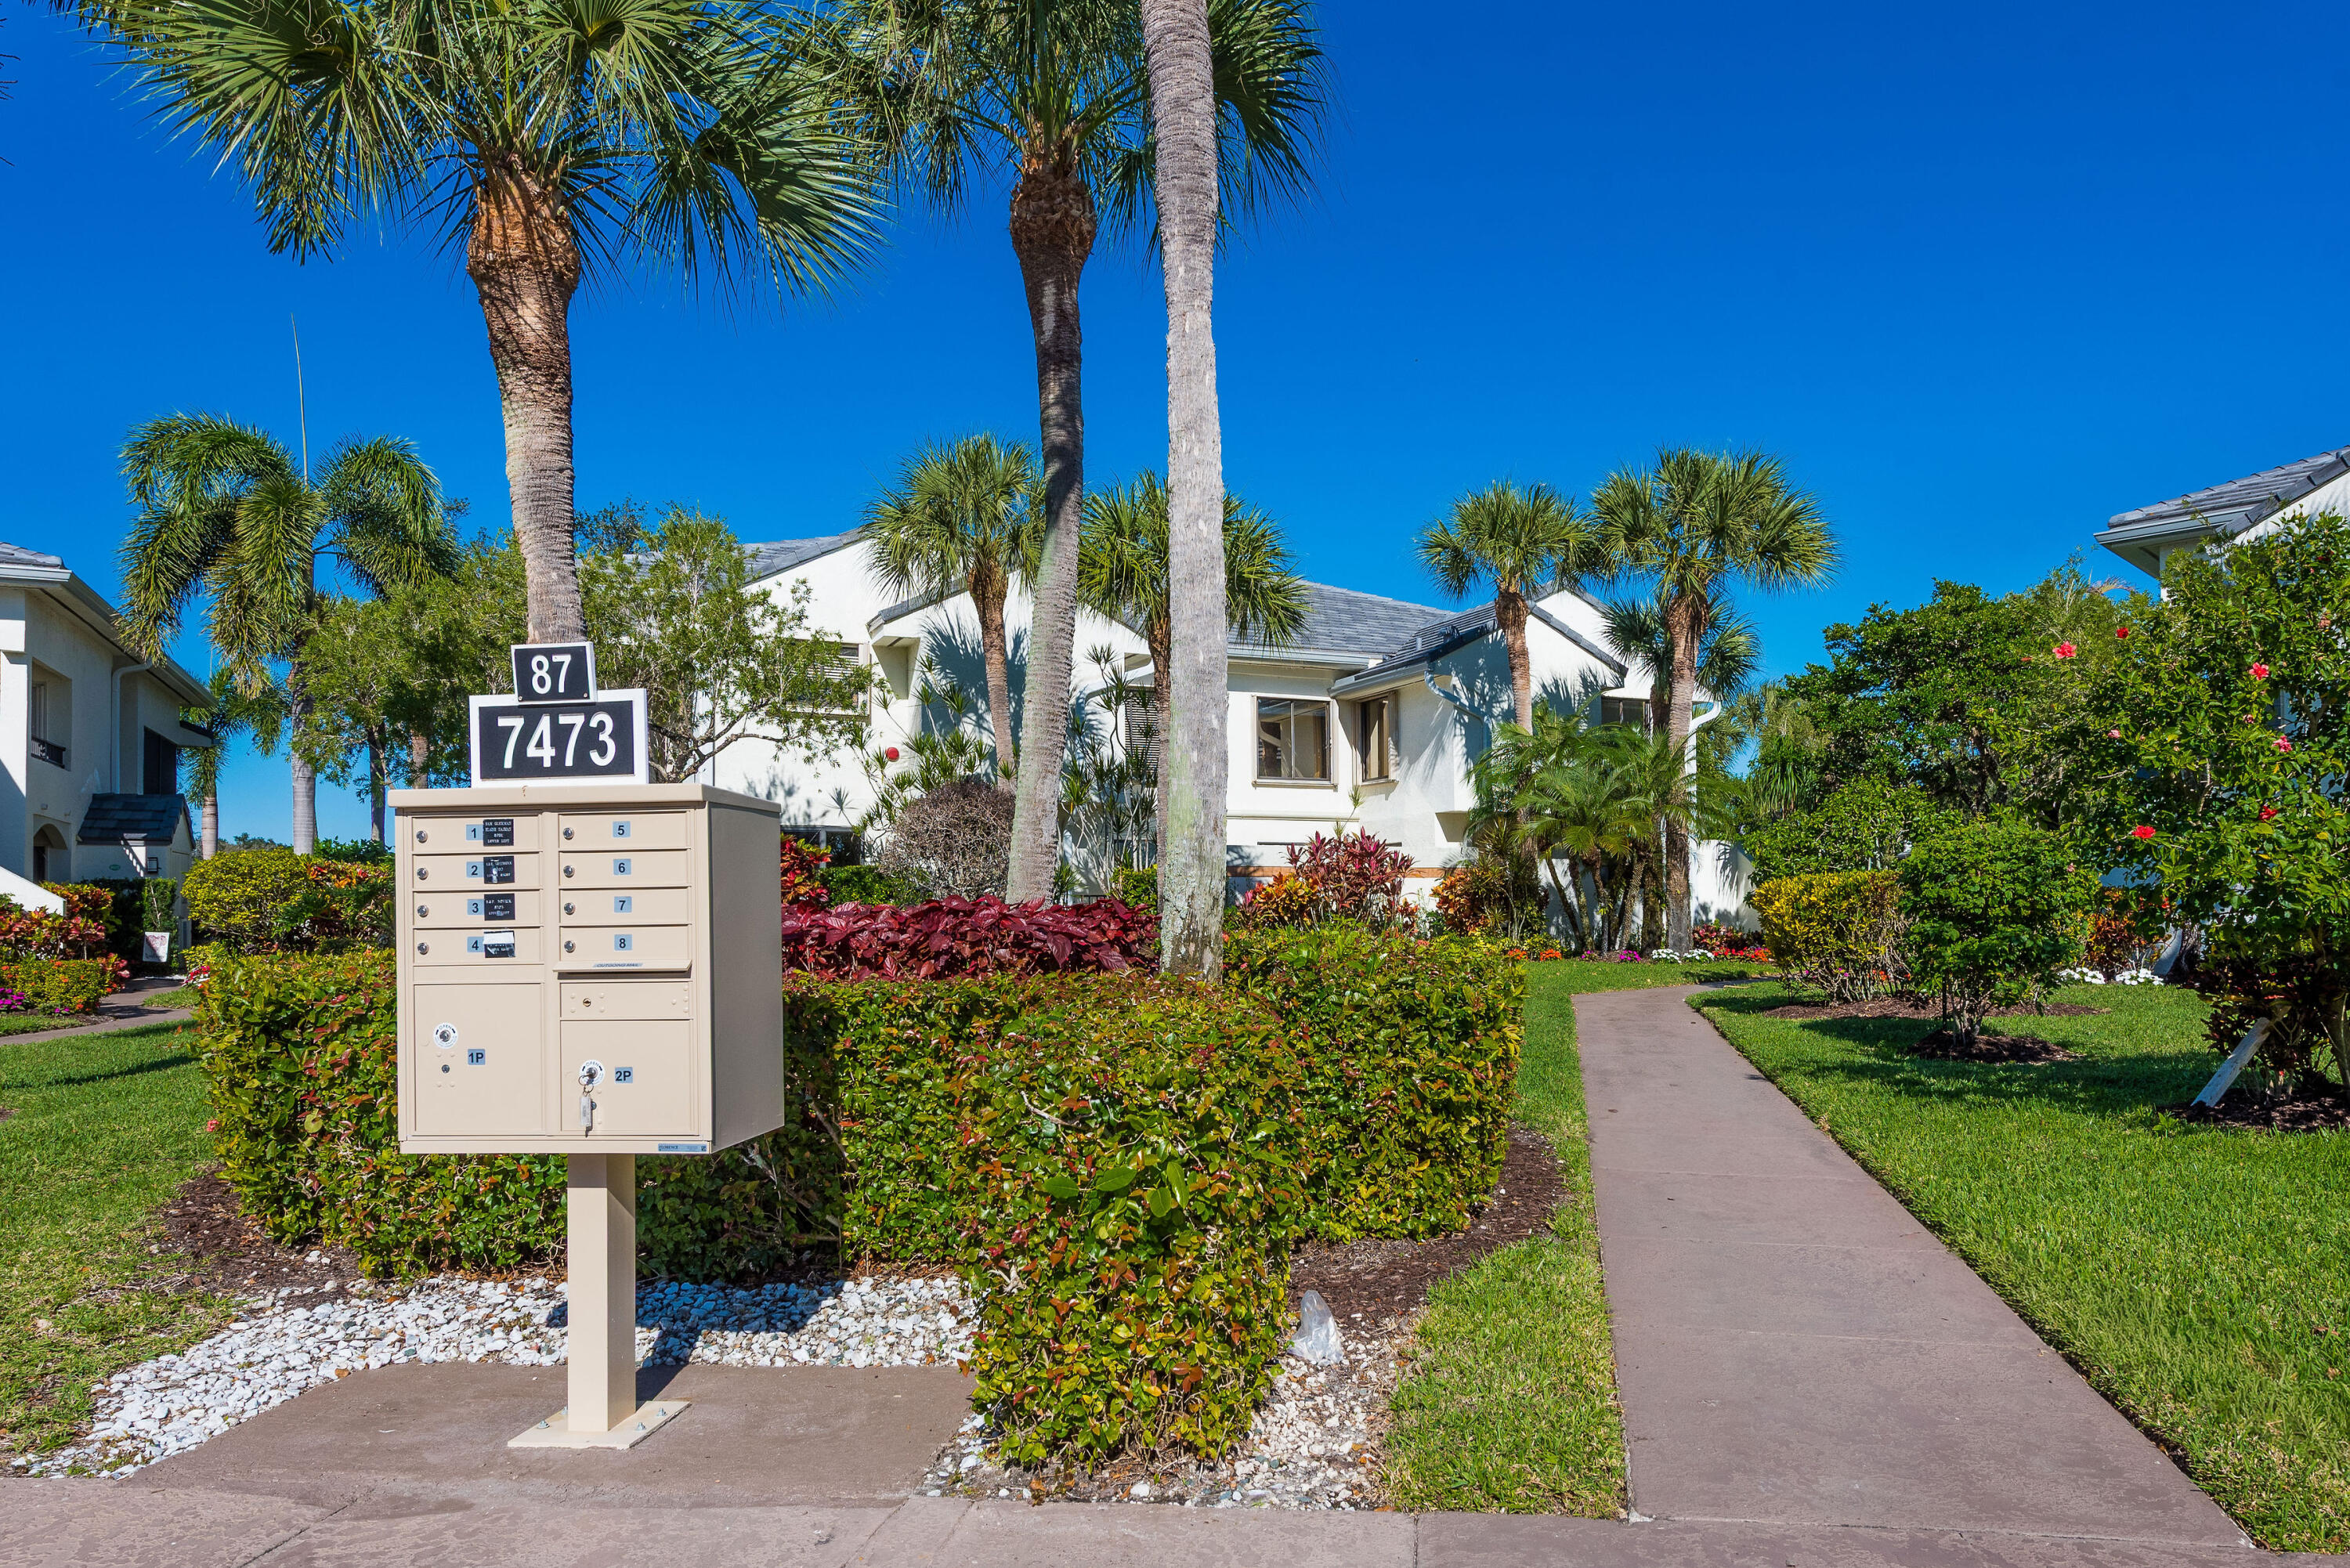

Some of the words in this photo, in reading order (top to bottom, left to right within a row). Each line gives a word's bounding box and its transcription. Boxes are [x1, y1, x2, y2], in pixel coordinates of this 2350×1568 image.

[531, 654, 572, 694] 87
[497, 711, 616, 769] 7473
[471, 827, 476, 839] 1
[617, 825, 625, 836] 5
[471, 865, 479, 876] 2
[618, 862, 626, 873] 6
[472, 902, 479, 913] 3
[619, 900, 627, 911] 7
[472, 940, 479, 951] 4
[619, 938, 627, 948] 8
[468, 1052, 484, 1064] 1P
[615, 1070, 631, 1082] 2P
